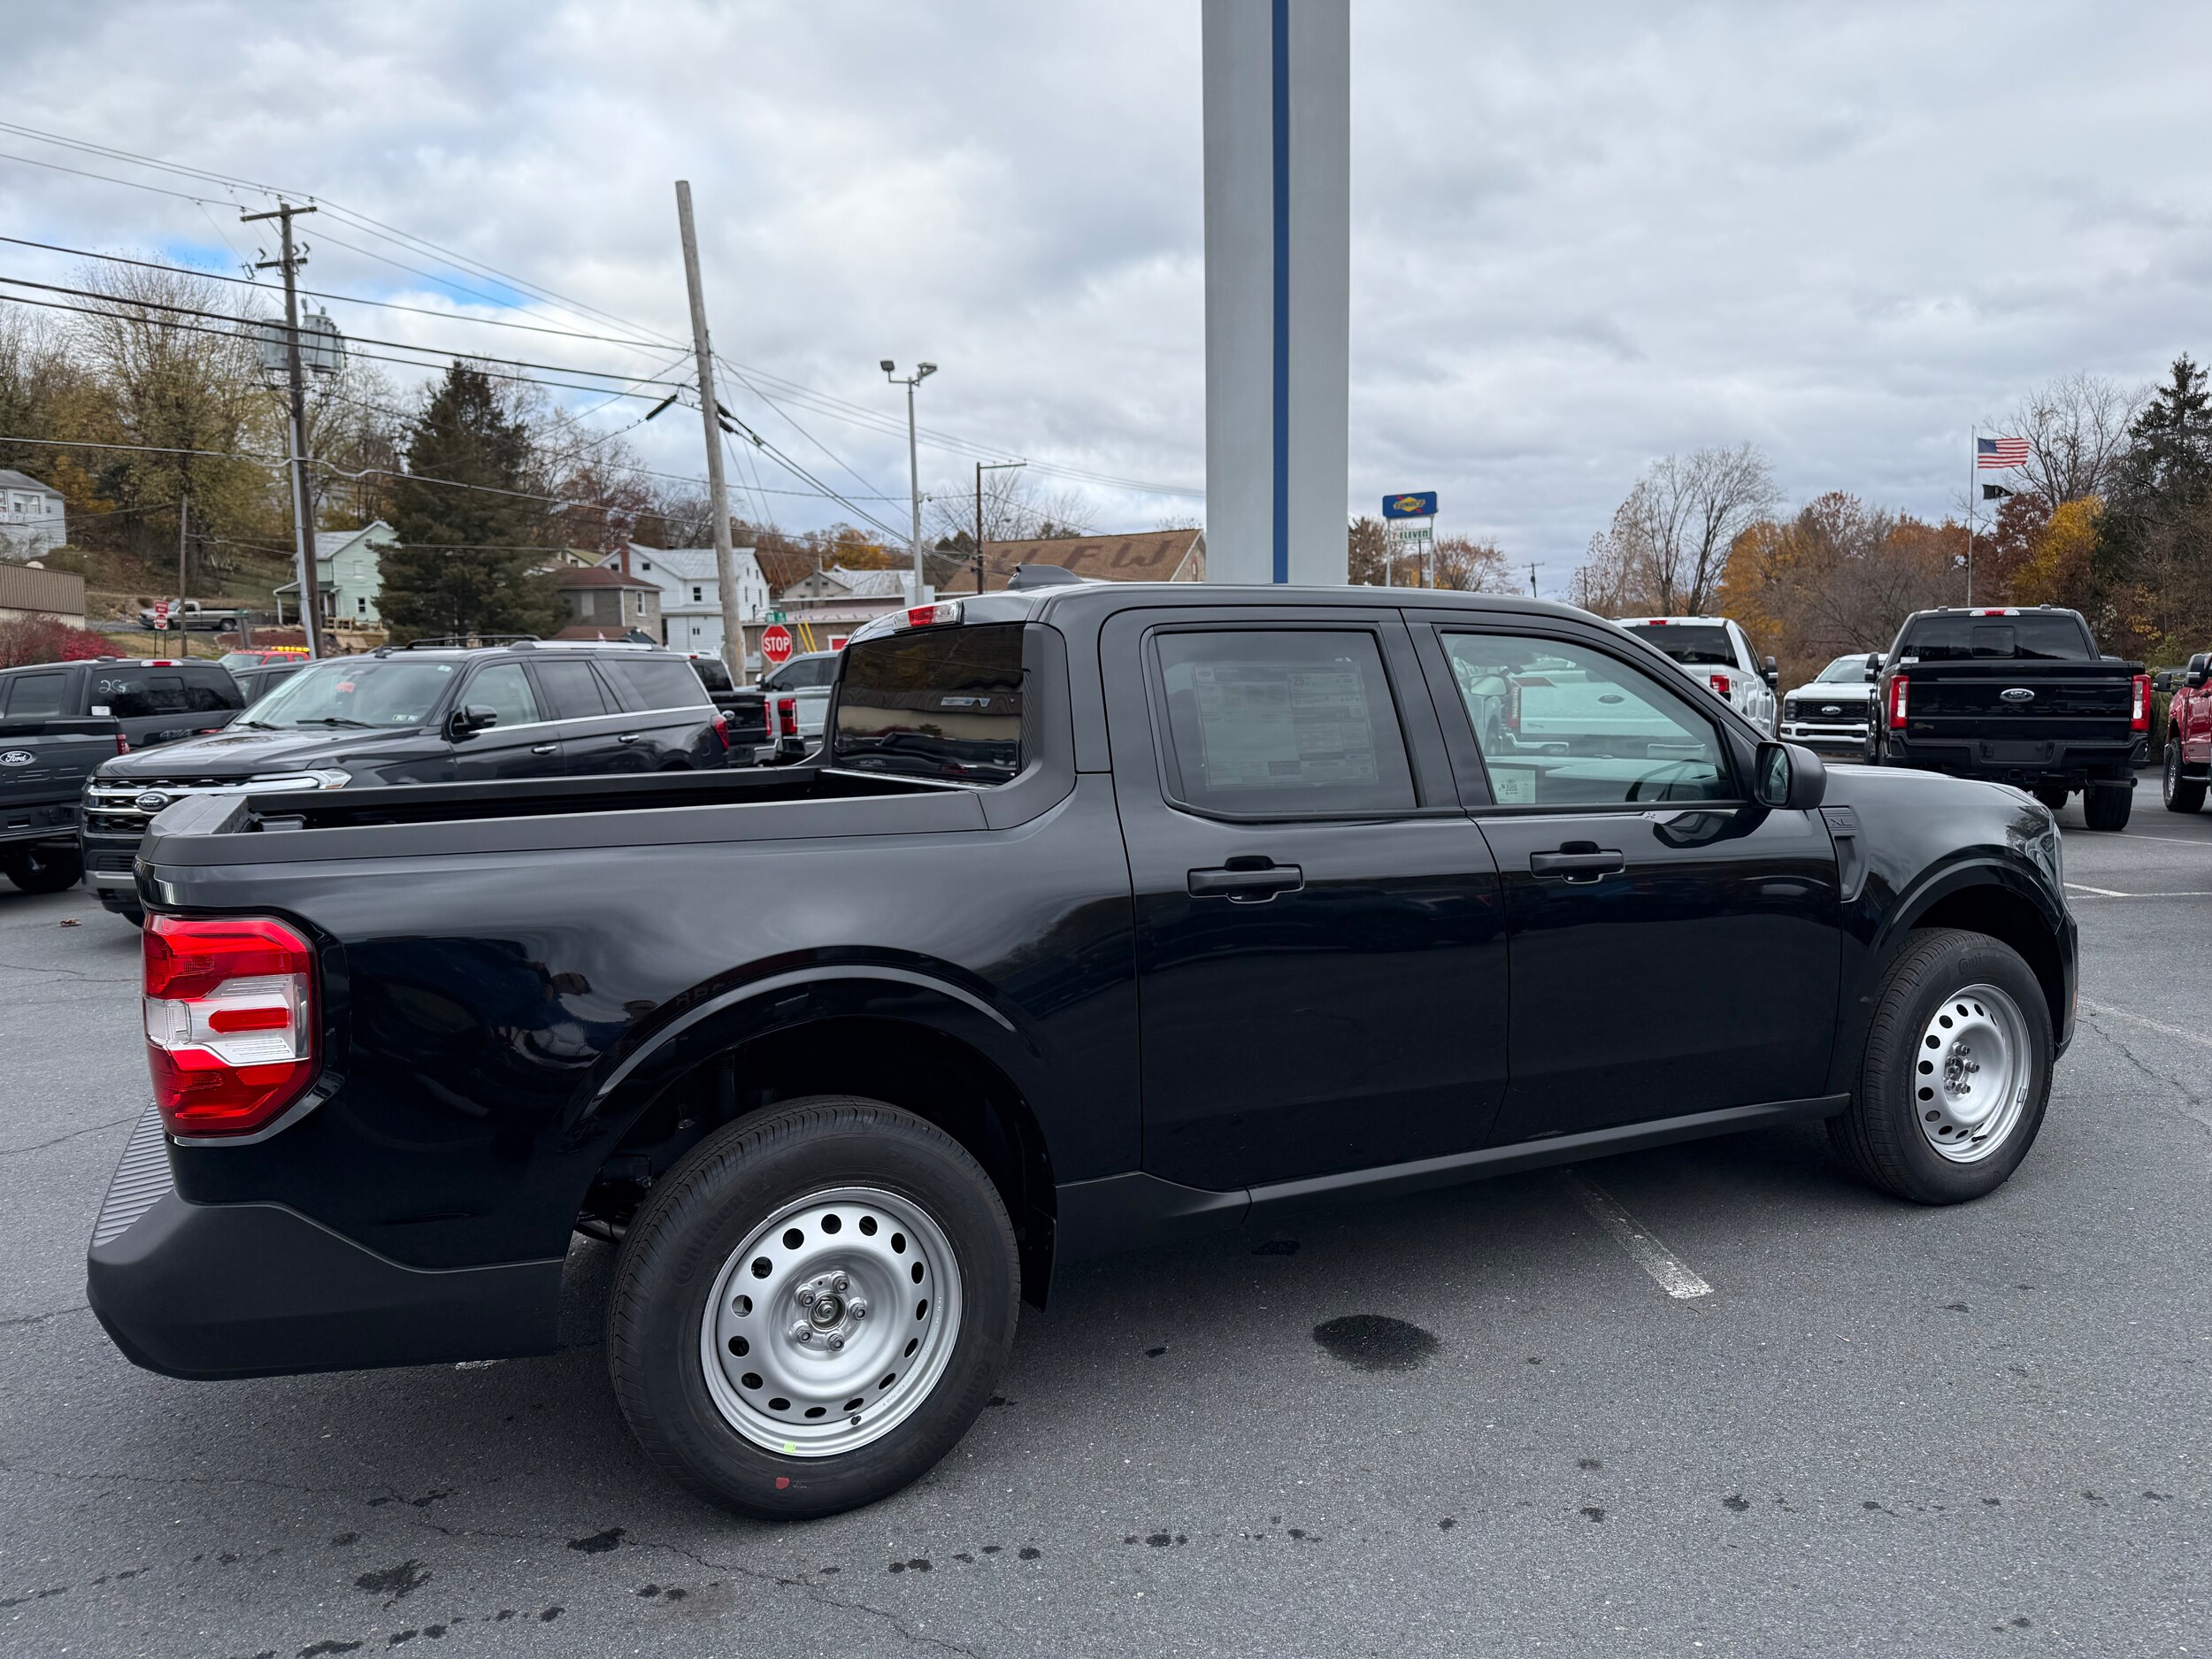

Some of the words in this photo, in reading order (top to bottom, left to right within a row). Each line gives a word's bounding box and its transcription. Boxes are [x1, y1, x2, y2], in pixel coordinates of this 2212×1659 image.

[764, 636, 790, 652] STOP
[5, 753, 27, 762] Ford
[1831, 818, 1853, 826] XL
